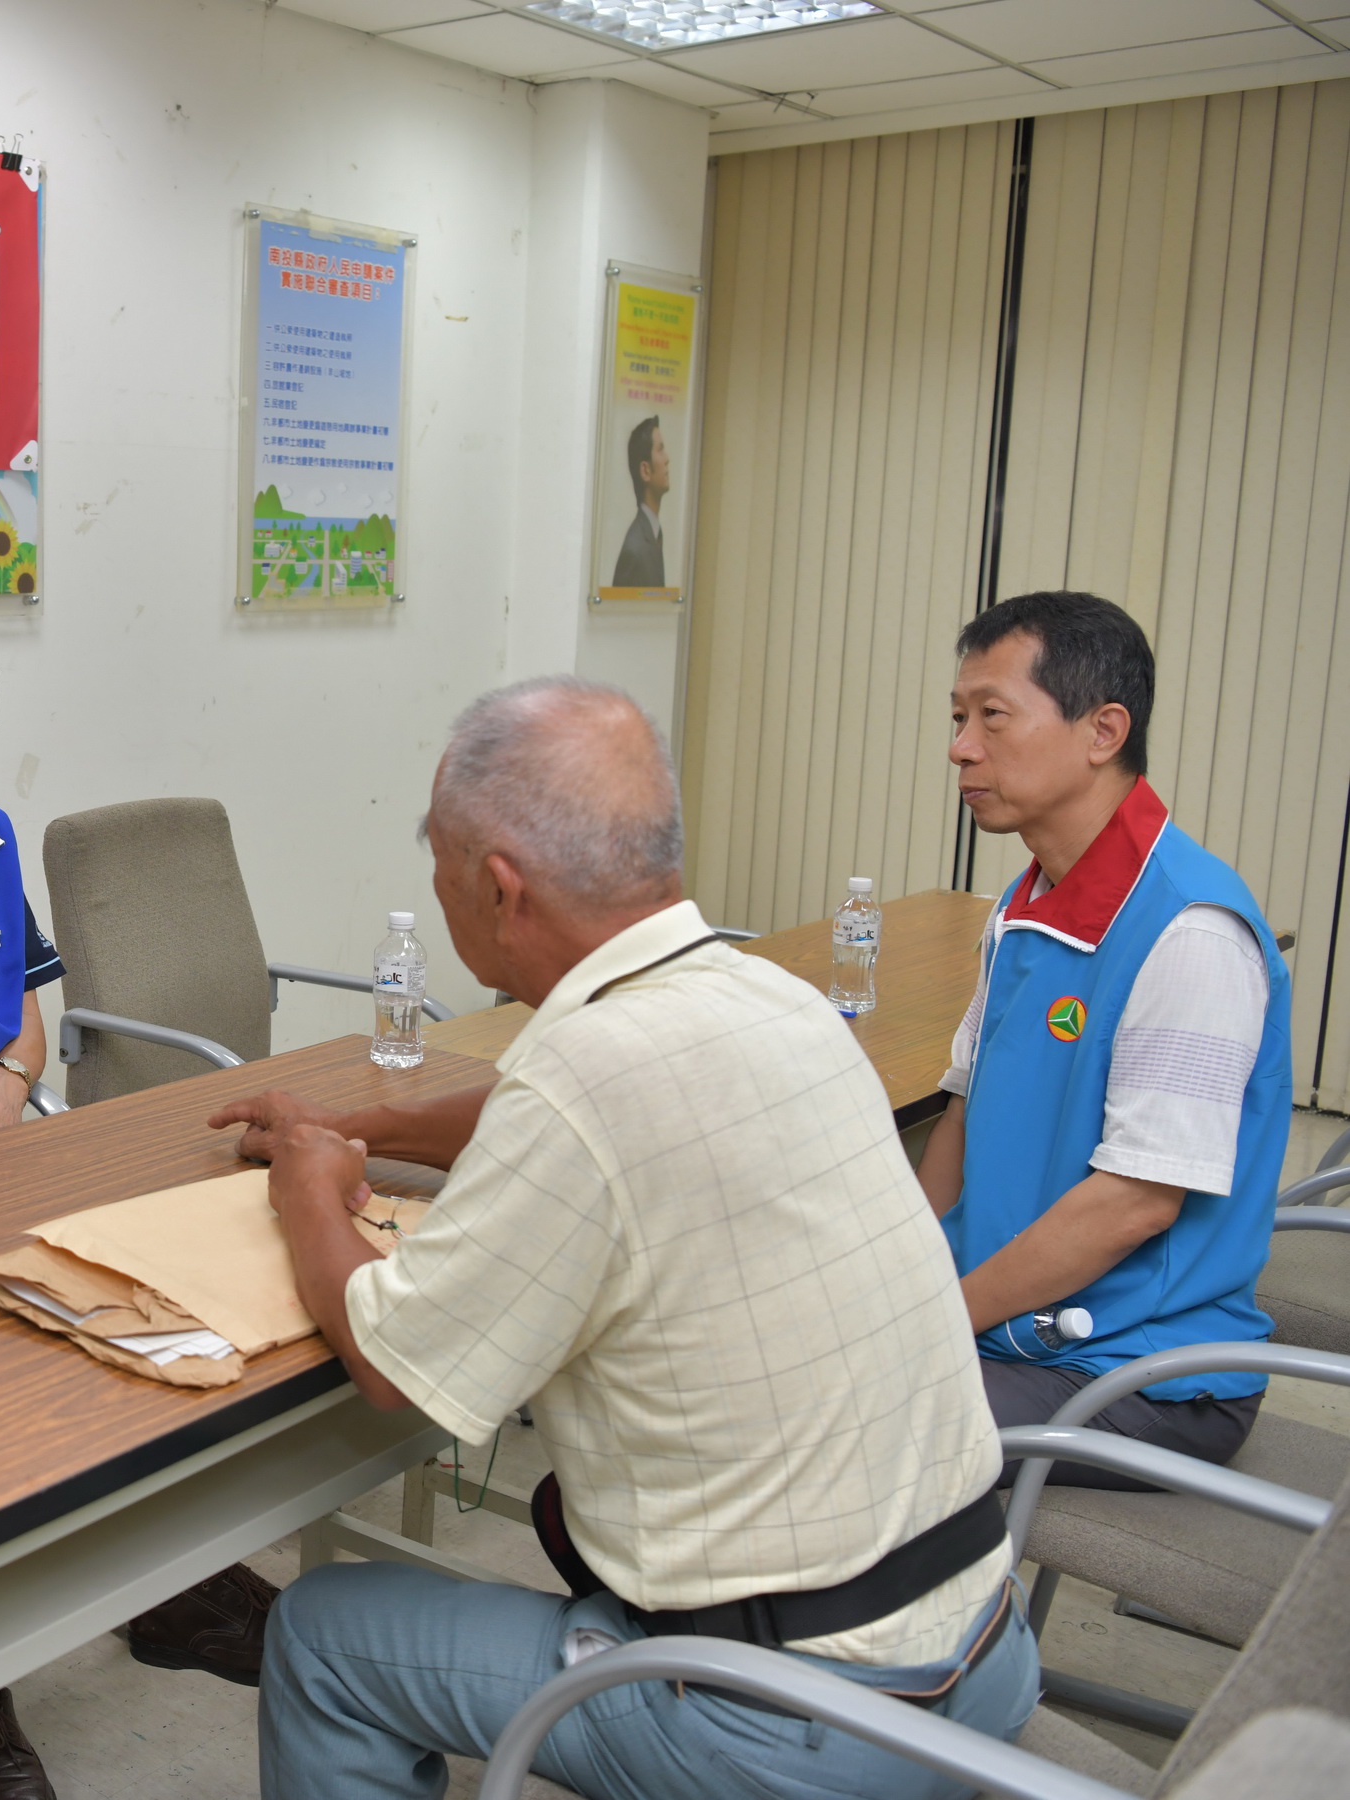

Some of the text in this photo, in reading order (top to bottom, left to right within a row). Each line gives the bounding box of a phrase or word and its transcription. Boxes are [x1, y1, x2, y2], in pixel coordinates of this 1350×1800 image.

[268, 246, 396, 284] 南投縣政府人民申請案件
